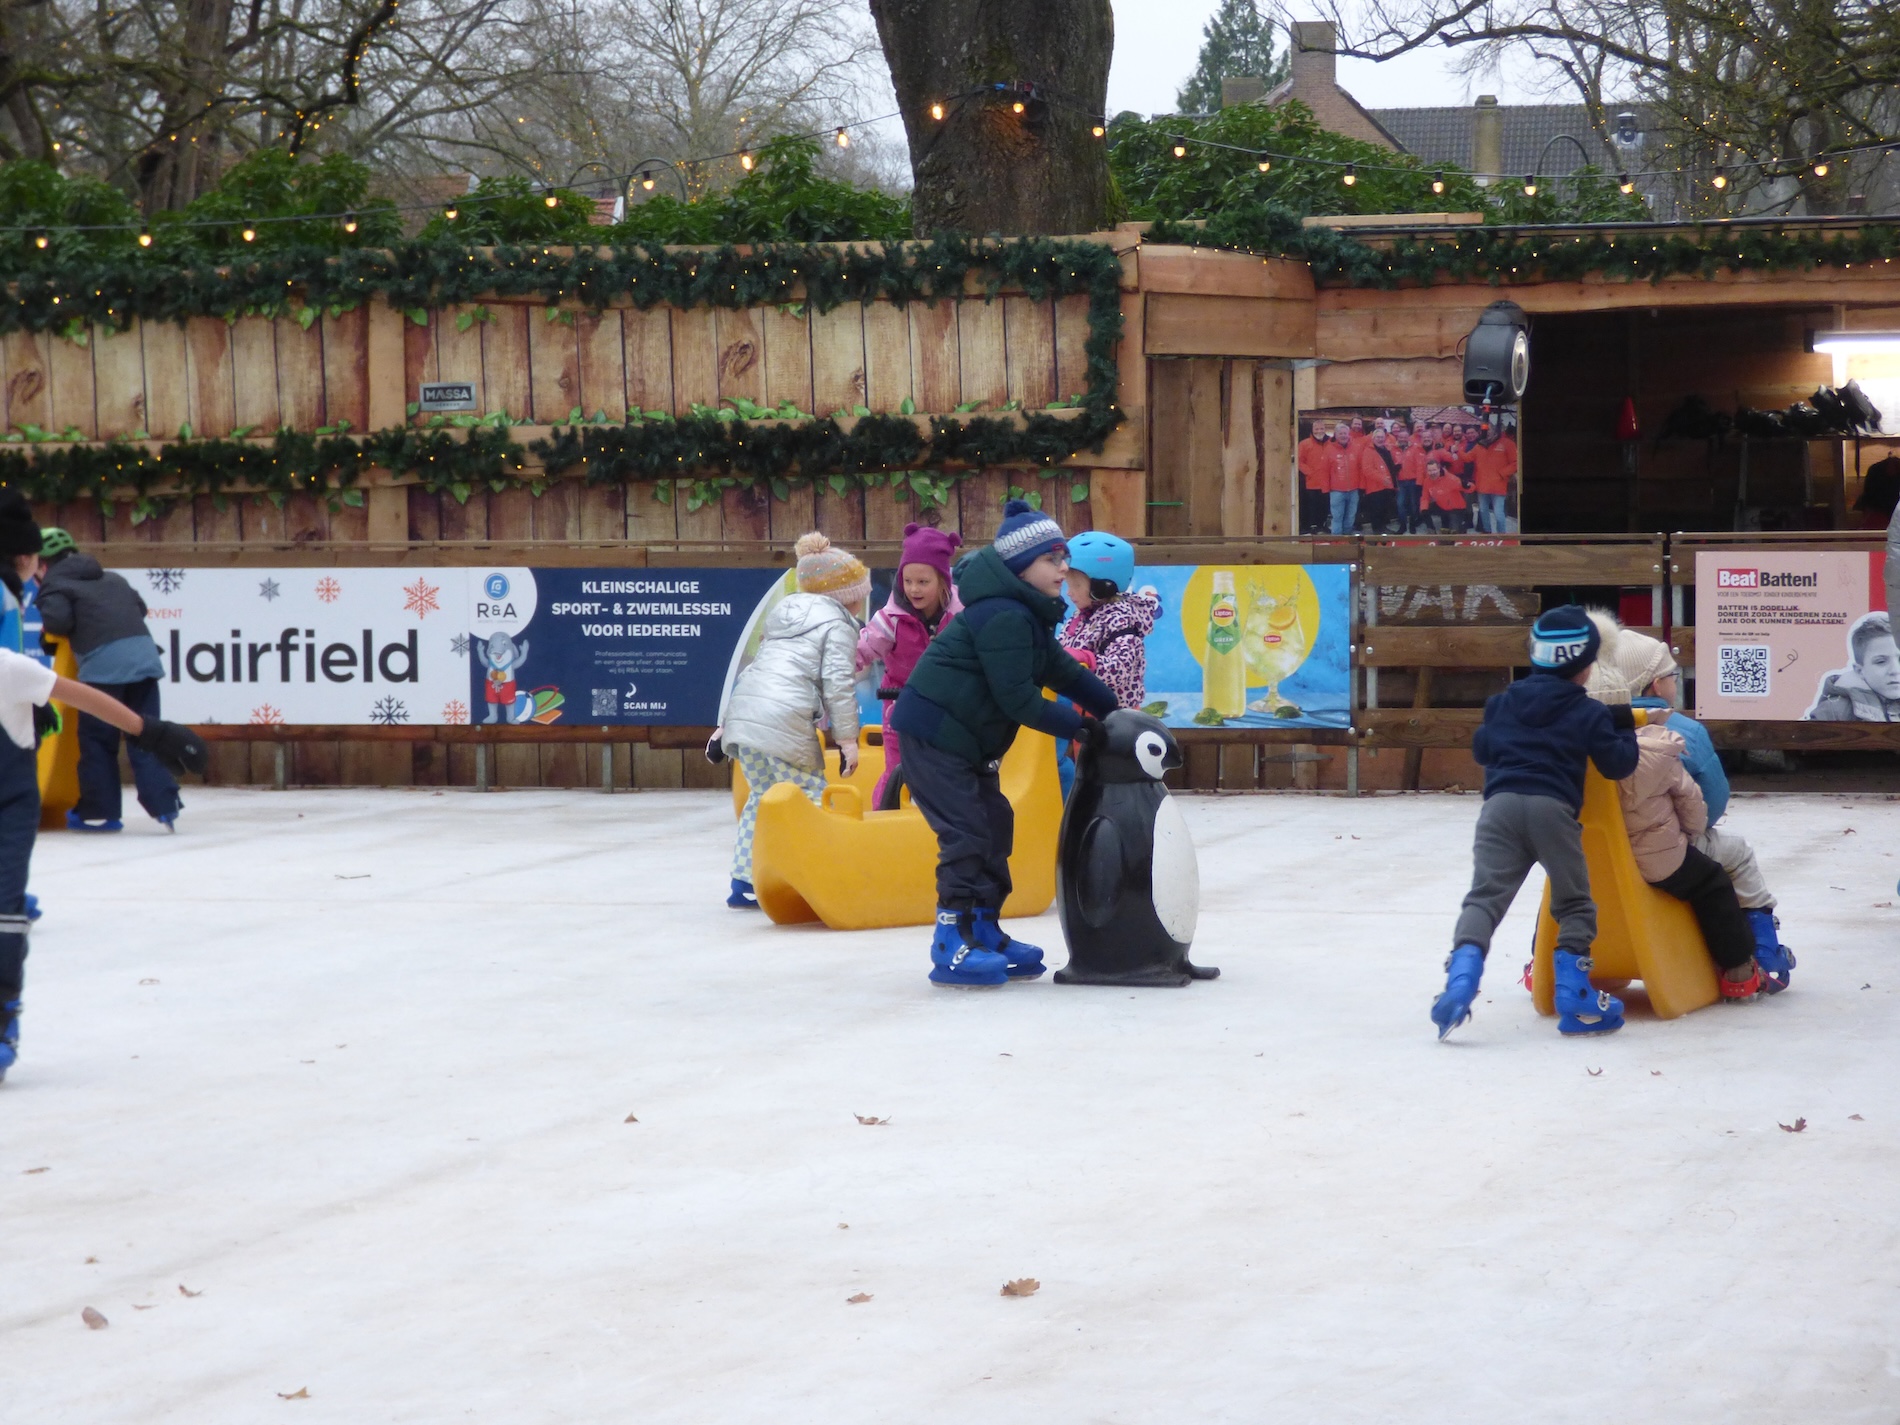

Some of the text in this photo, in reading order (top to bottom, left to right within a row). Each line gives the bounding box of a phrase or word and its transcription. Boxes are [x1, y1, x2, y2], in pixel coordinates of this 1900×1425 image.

[425, 388, 469, 400] MASSA
[1719, 570, 1817, 587] Beat Batten!
[582, 581, 700, 594] KLEINSCHALIGE
[147, 608, 183, 619] EVENT
[551, 602, 731, 616] SPORT- & ZWEMLESSEN
[582, 624, 701, 637] VOOR IEDEREEN
[157, 627, 419, 683] lairfield
[616, 659, 635, 667] goede
[623, 702, 667, 710] SCAN MIJ
